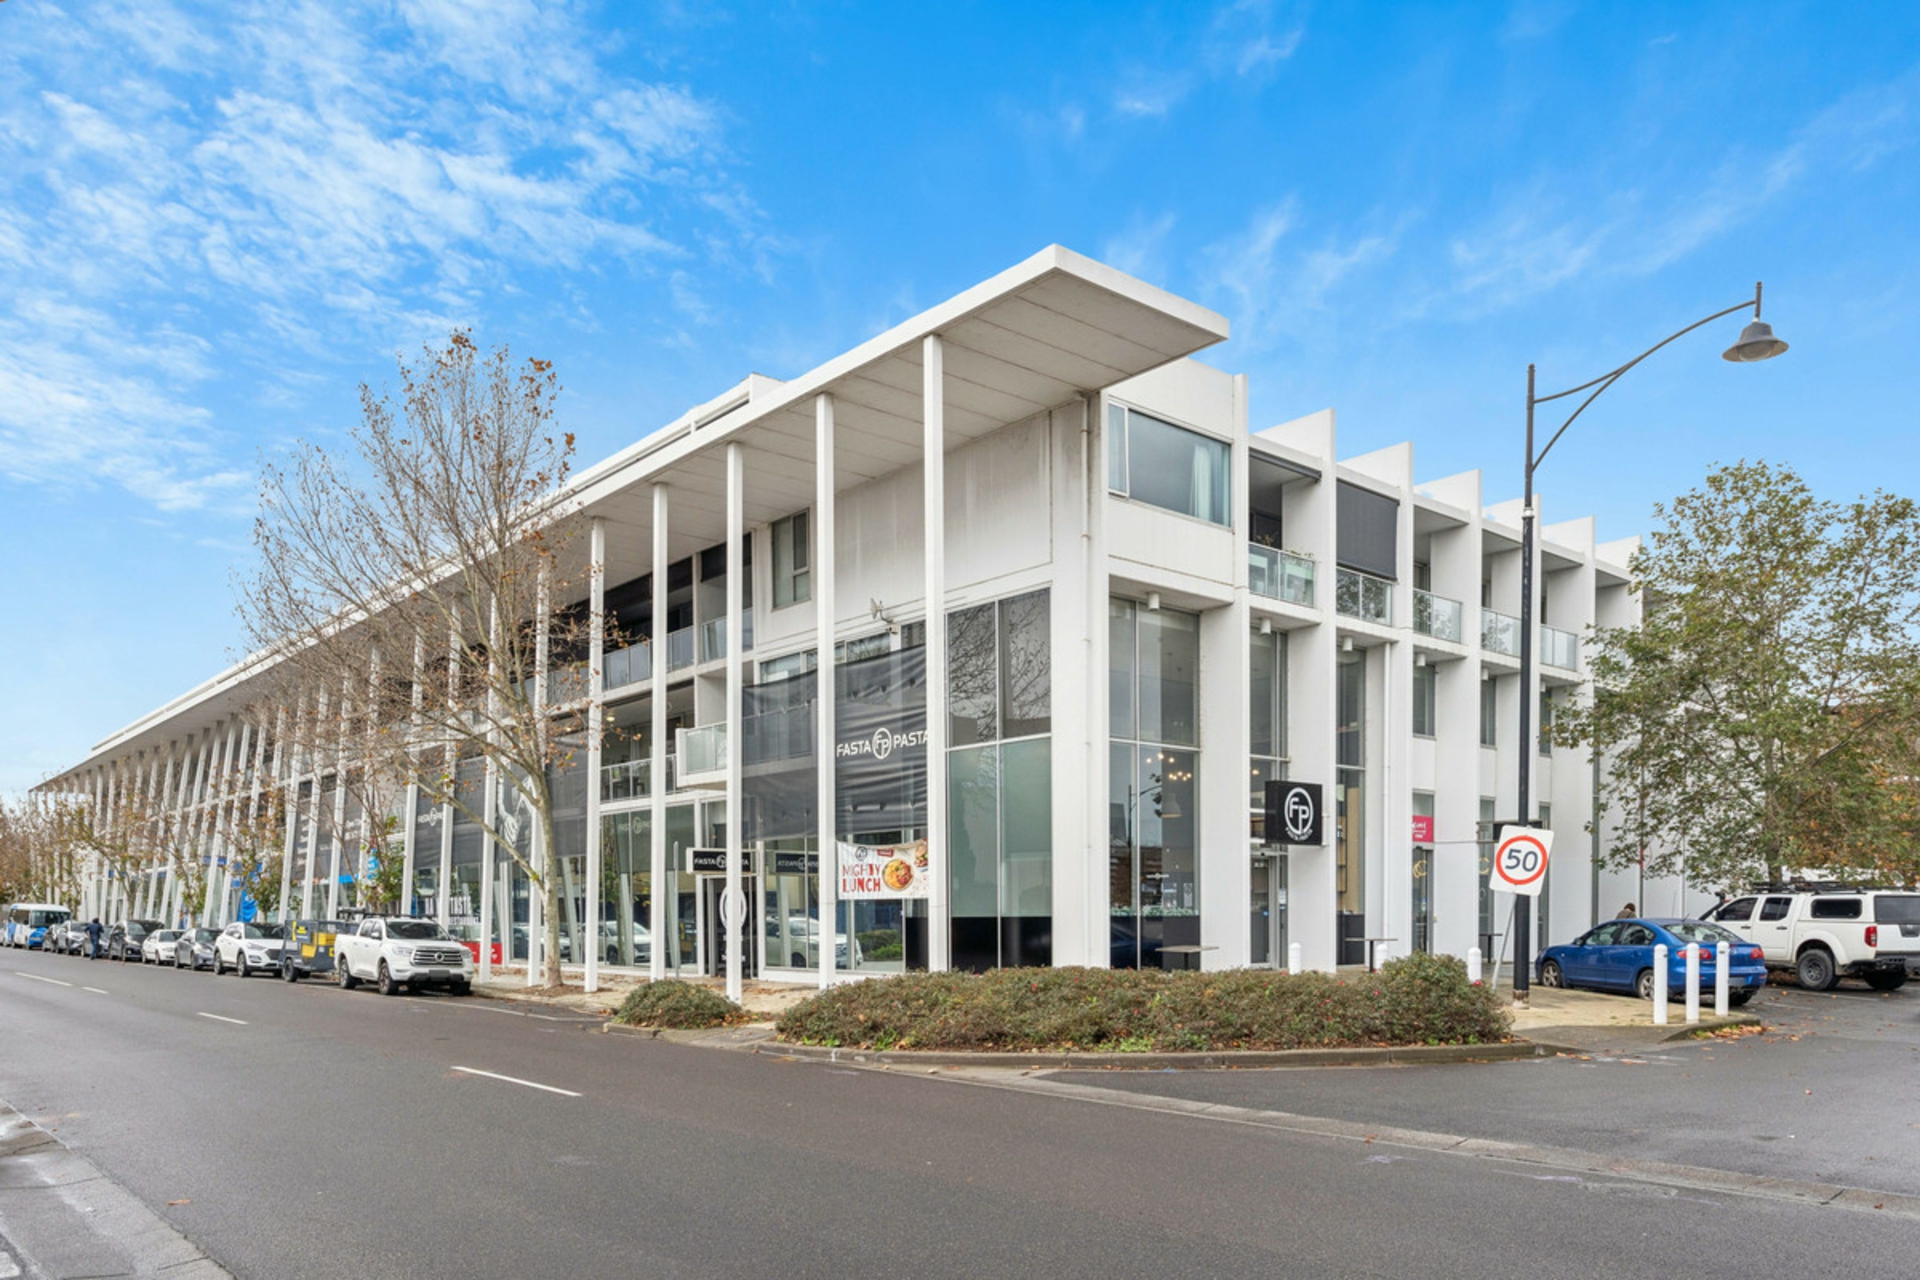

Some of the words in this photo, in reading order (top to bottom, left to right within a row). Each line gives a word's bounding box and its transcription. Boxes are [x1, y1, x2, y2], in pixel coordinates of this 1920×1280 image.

[836, 741, 872, 757] FASTA
[892, 730, 928, 749] PASTA
[1287, 792, 1312, 834] FP
[842, 863, 882, 877] MIGHTY
[1505, 848, 1539, 872] 50
[842, 878, 882, 893] LUNCH
